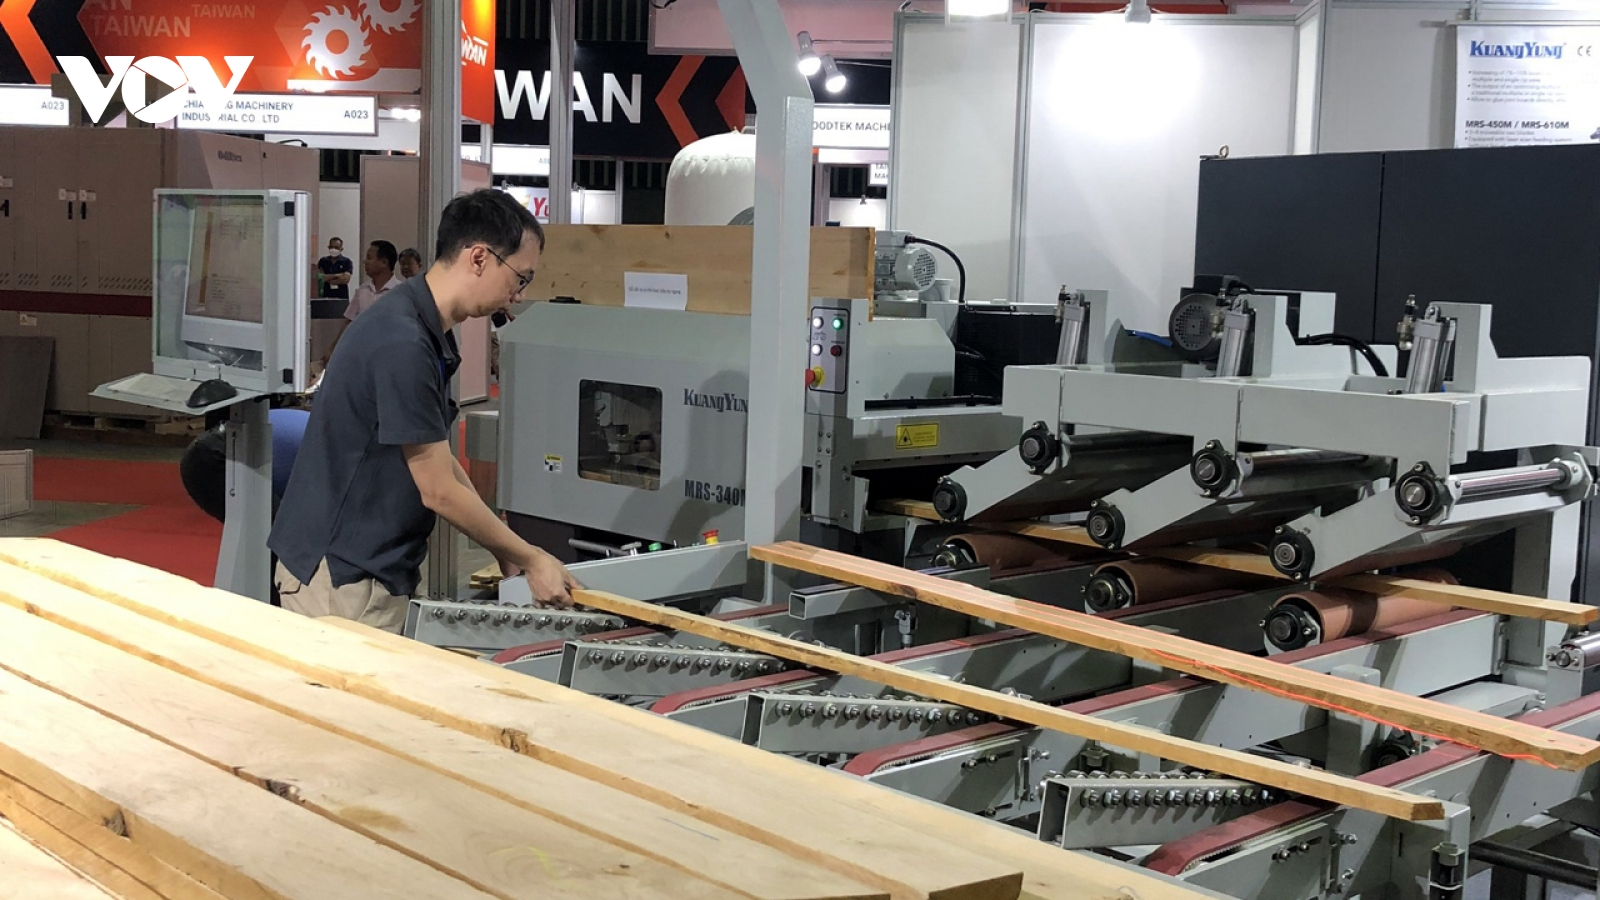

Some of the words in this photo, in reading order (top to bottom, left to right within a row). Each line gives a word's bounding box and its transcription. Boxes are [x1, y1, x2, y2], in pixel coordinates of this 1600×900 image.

[191, 4, 256, 19] TAIWAN
[90, 15, 191, 37] TAIWAN
[41, 101, 65, 110] A023
[236, 101, 294, 111] MACHINERY
[182, 112, 238, 122] INDUSRIAL
[262, 114, 280, 123] LTD
[344, 110, 369, 120] A023
[1465, 120, 1512, 129] MRS-450M
[1521, 121, 1570, 129] MRS-610M
